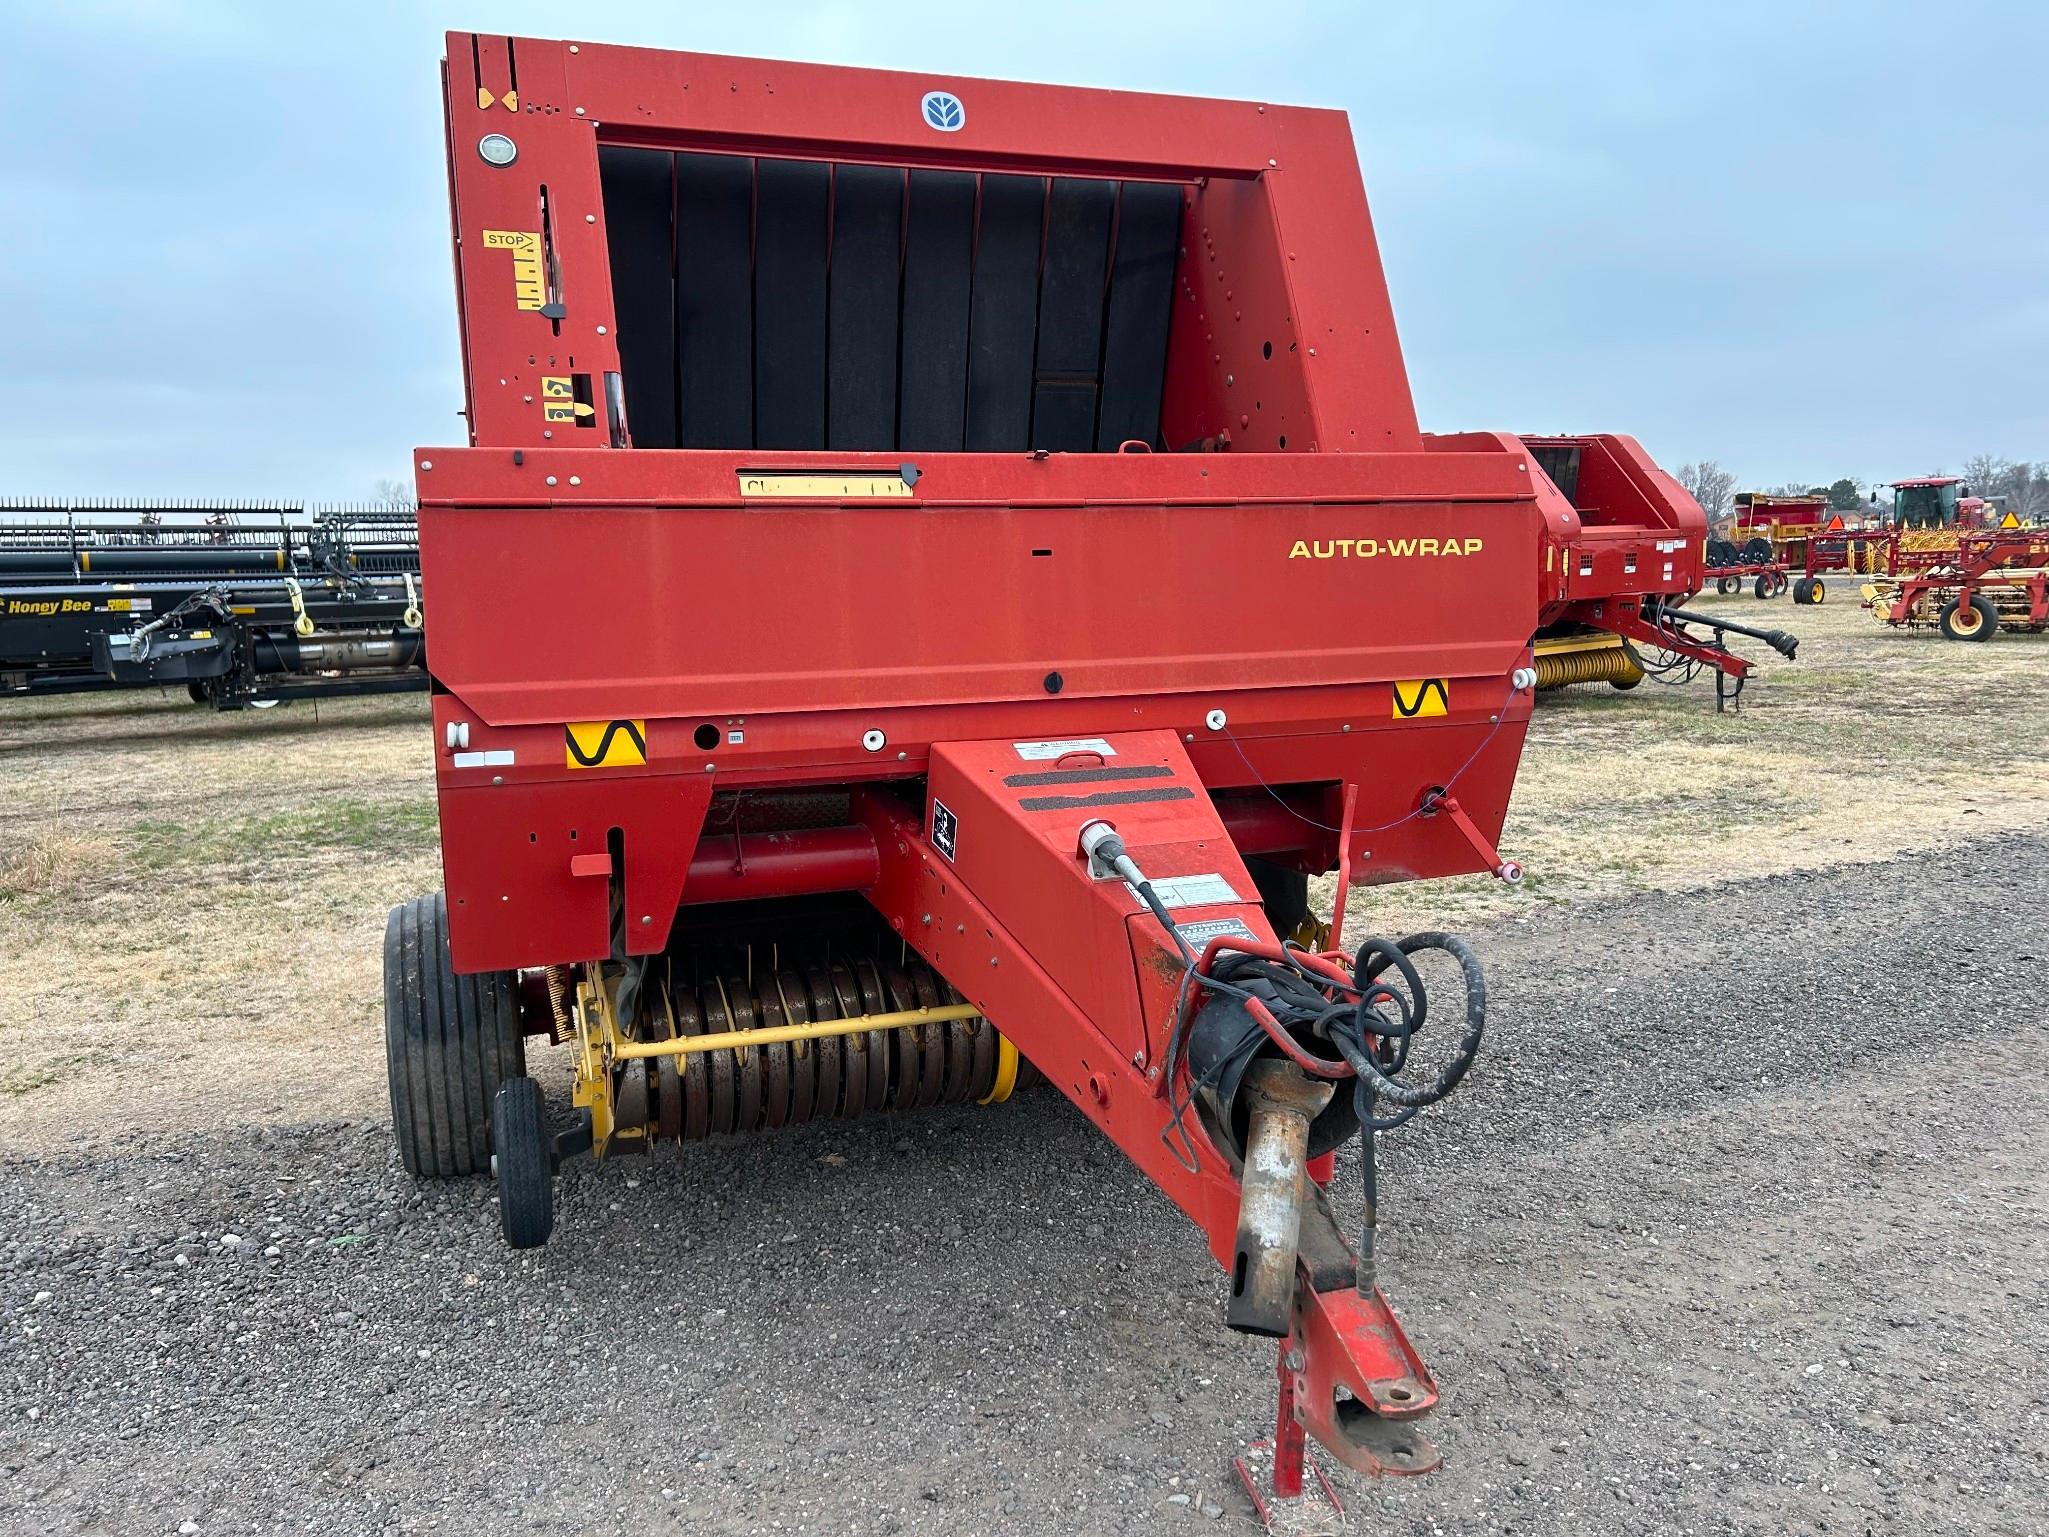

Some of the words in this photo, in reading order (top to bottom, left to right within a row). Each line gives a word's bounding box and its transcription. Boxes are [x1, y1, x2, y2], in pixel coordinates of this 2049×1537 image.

[488, 234, 524, 245] STOP
[1288, 538, 1483, 559] AUTO-WRAP
[8, 600, 59, 616] Honey
[61, 599, 92, 612] Bee
